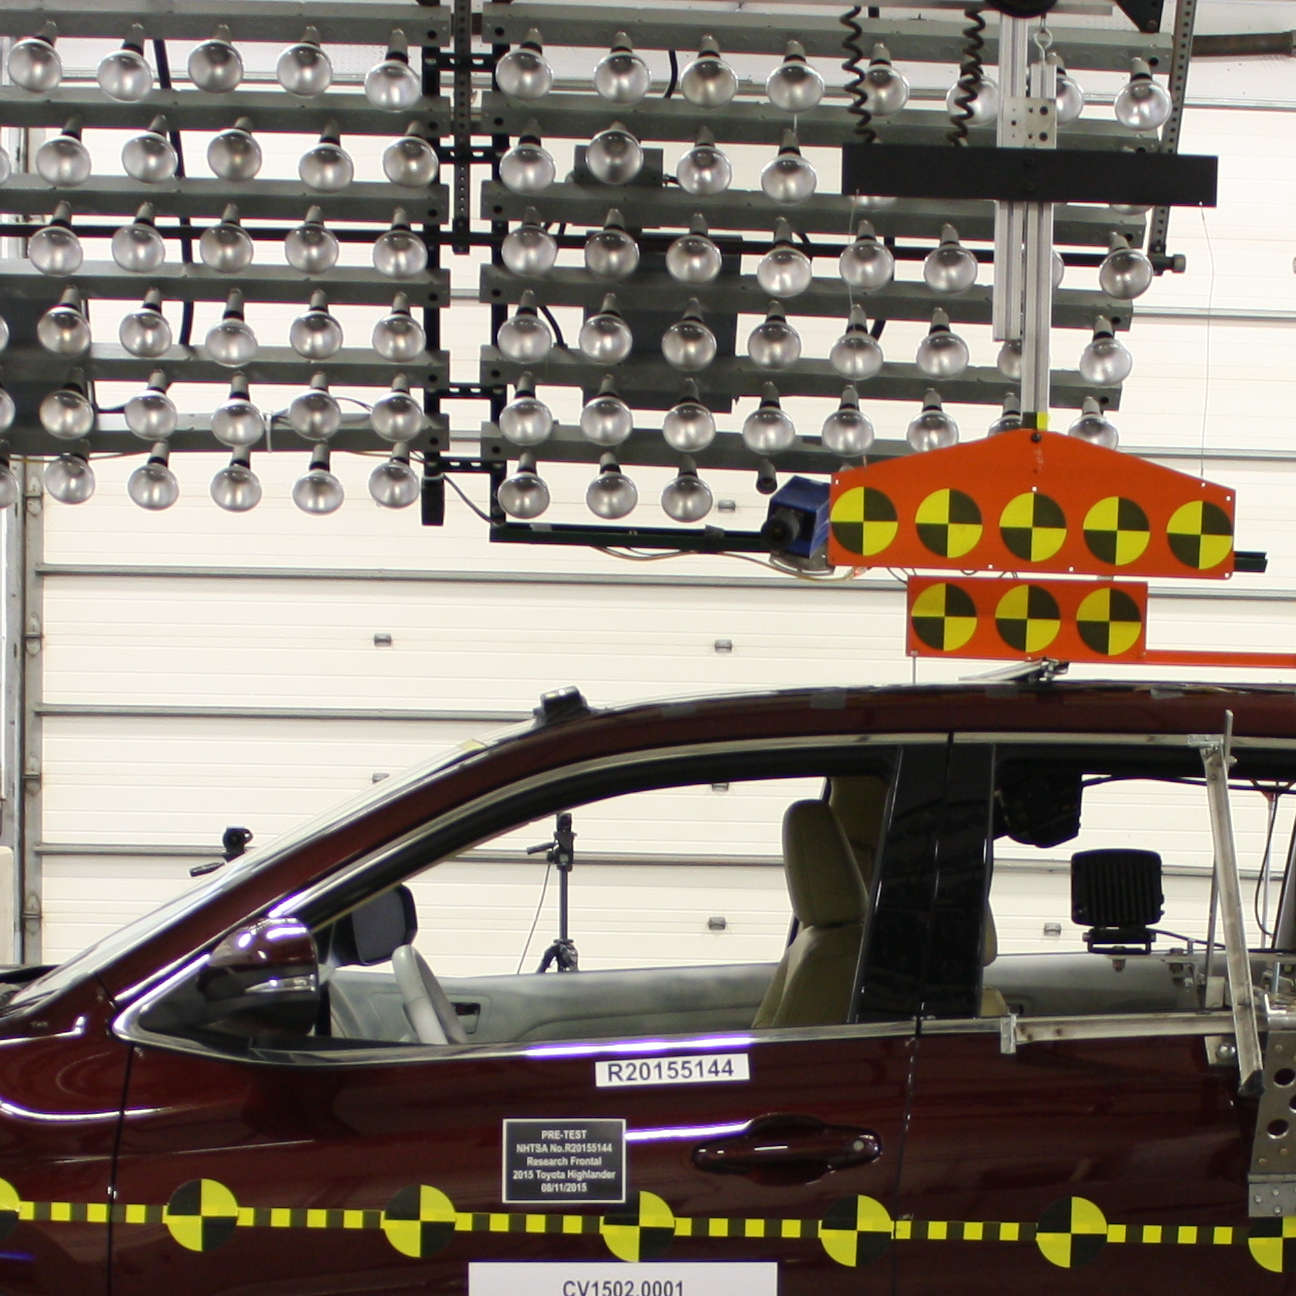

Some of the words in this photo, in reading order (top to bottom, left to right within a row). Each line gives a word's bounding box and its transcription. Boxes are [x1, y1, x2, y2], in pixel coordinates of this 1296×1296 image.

[607, 1058, 735, 1082] R20155144
[541, 1129, 588, 1140] PRE-TEST
[516, 1143, 549, 1153] NHTSA
[526, 1156, 568, 1166] Research
[570, 1155, 603, 1166] Frontal
[512, 1169, 534, 1180] 2015
[535, 1169, 566, 1181] Toyota
[567, 1169, 616, 1181] Highlander
[540, 1182, 588, 1193] 08/11/2015
